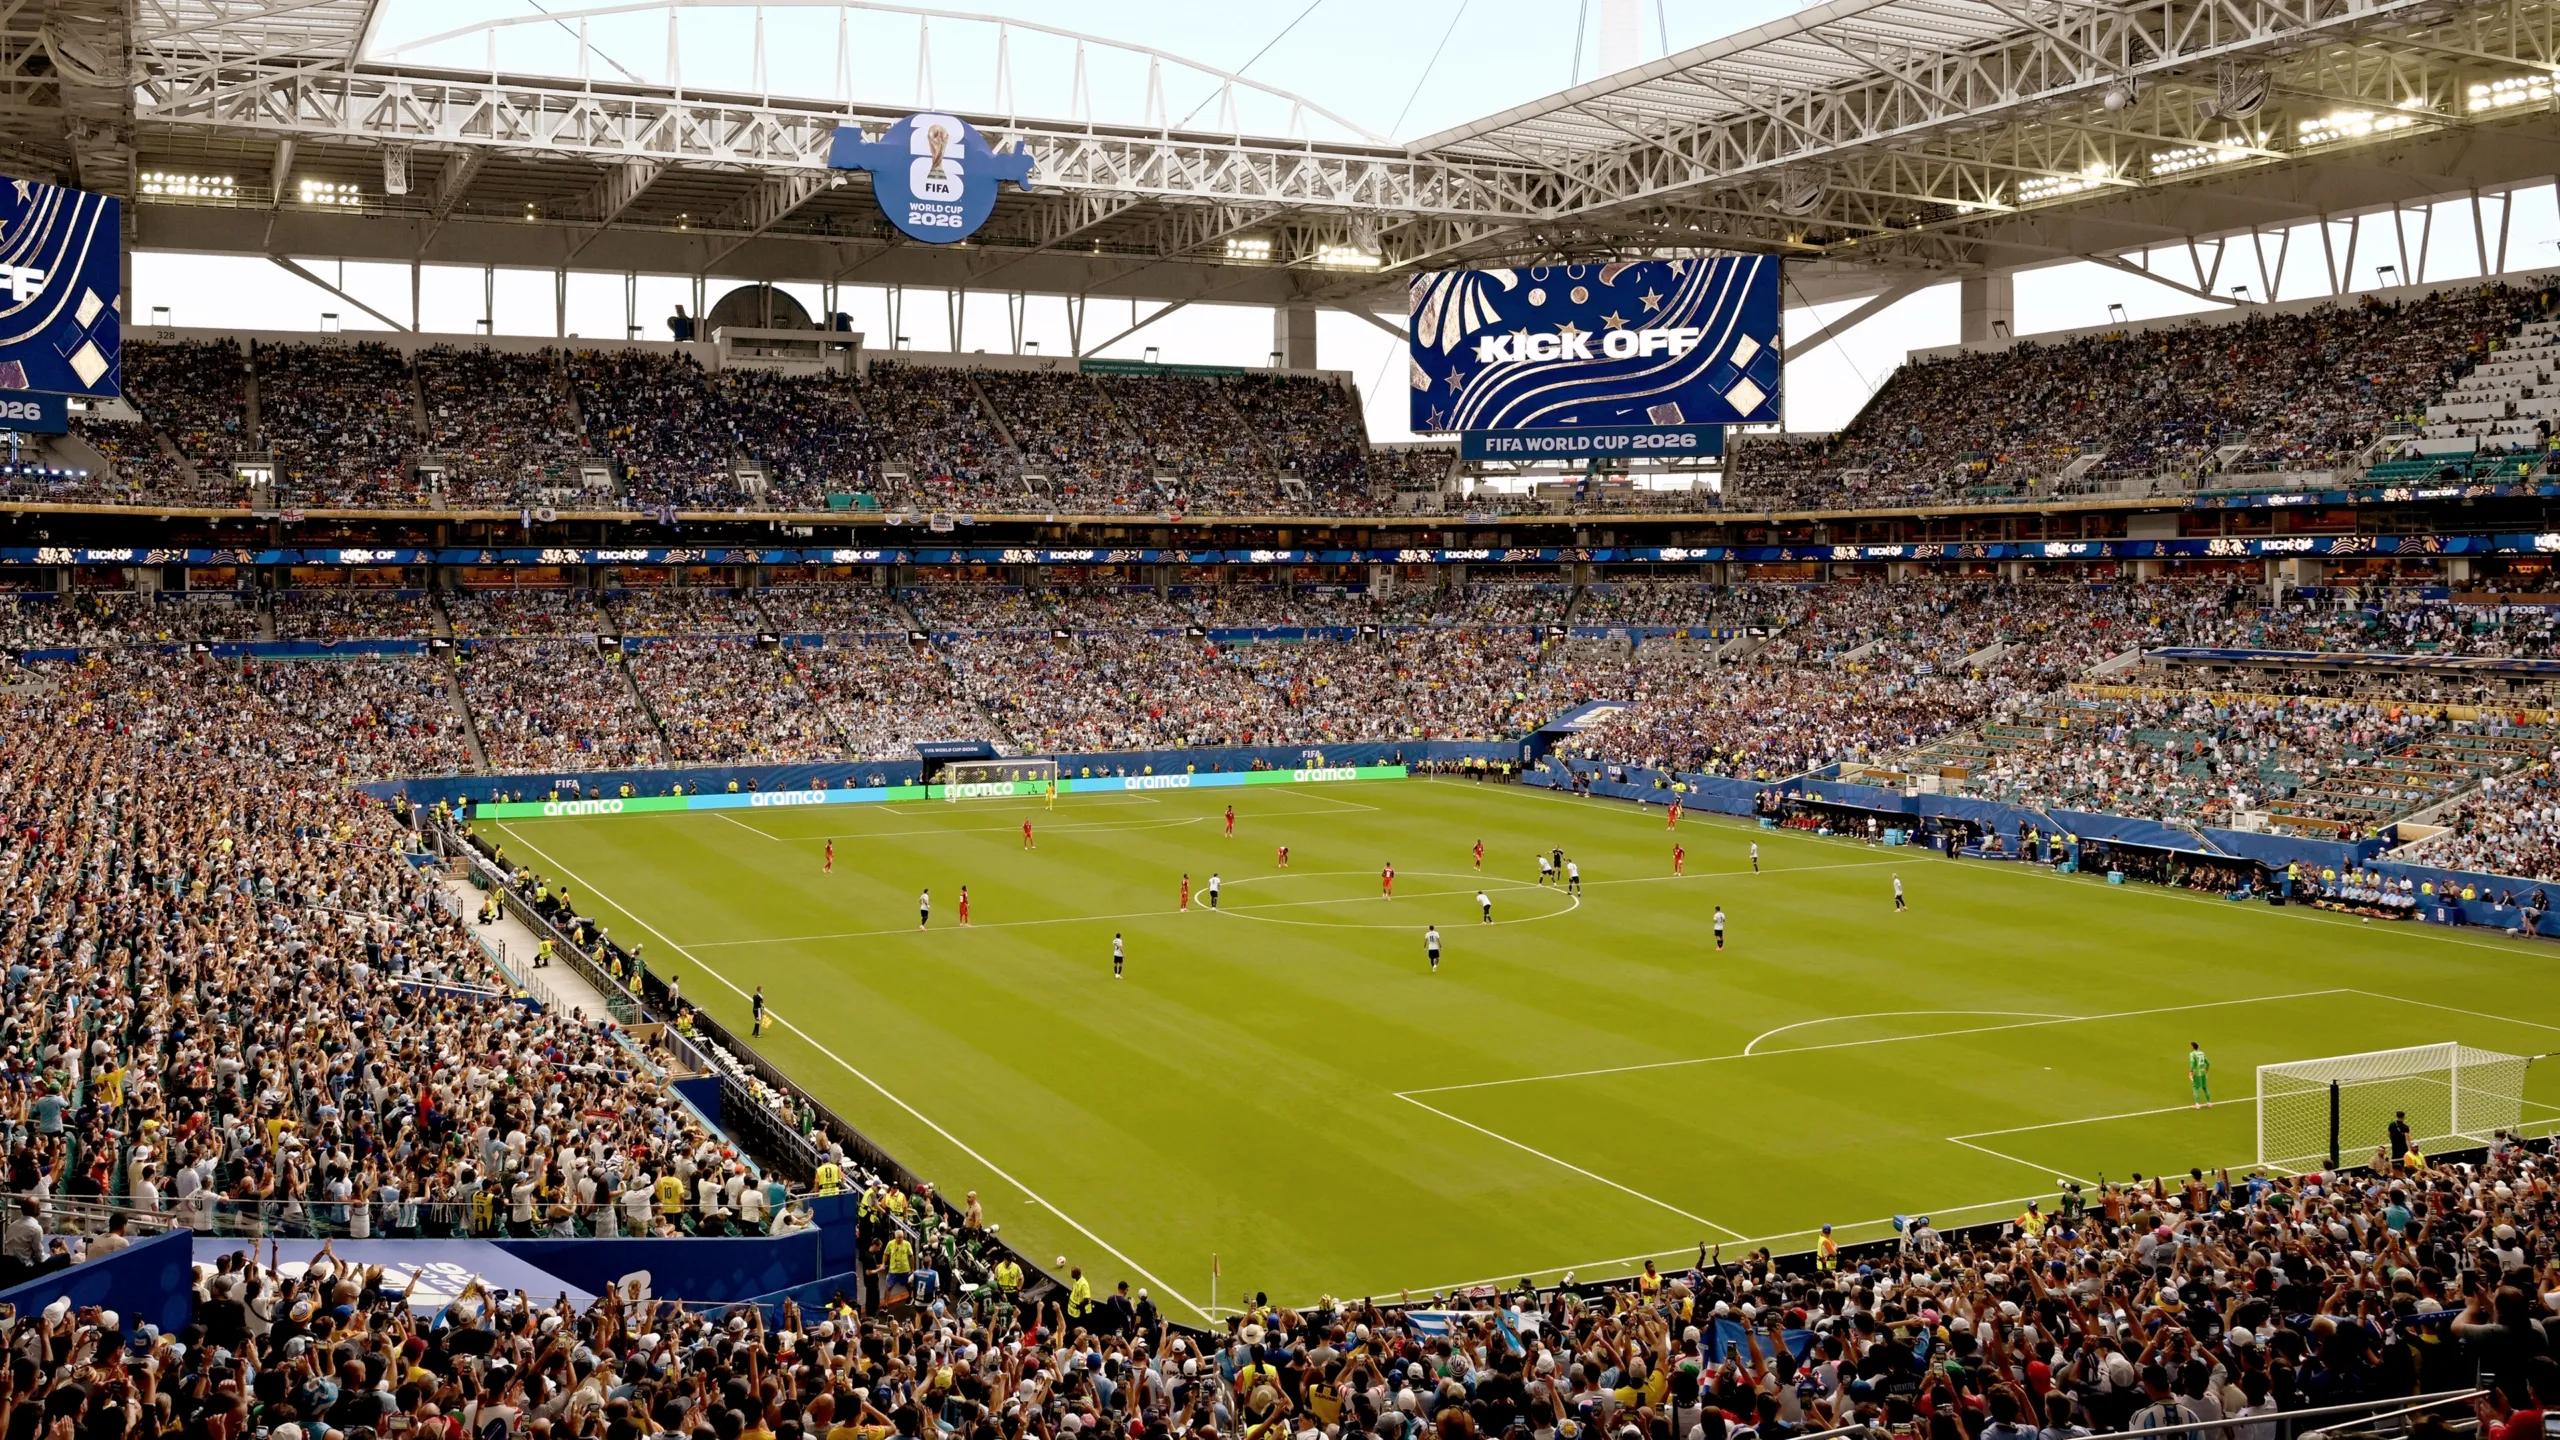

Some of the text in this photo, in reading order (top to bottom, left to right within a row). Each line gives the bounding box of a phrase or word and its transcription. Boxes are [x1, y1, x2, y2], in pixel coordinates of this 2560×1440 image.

[925, 183, 950, 195] FIFA
[909, 202, 964, 215] WORLD CUP
[908, 212, 963, 228] 2026
[156, 331, 176, 341] 328
[320, 336, 338, 346] 329
[1480, 327, 1700, 364] KICK OFF
[895, 357, 911, 366] 333
[1486, 433, 1697, 453] FIFA WORLD CUP 2026
[1302, 750, 1320, 758] FIFA
[1293, 767, 1357, 783] aramco
[1607, 765, 1622, 775] FIFA
[555, 779, 580, 789] FIFA
[1124, 774, 1190, 790] aramco
[944, 781, 1015, 798] aramco
[750, 789, 826, 807] aramco
[543, 799, 624, 816] aramco
[663, 1186, 672, 1200] 10
